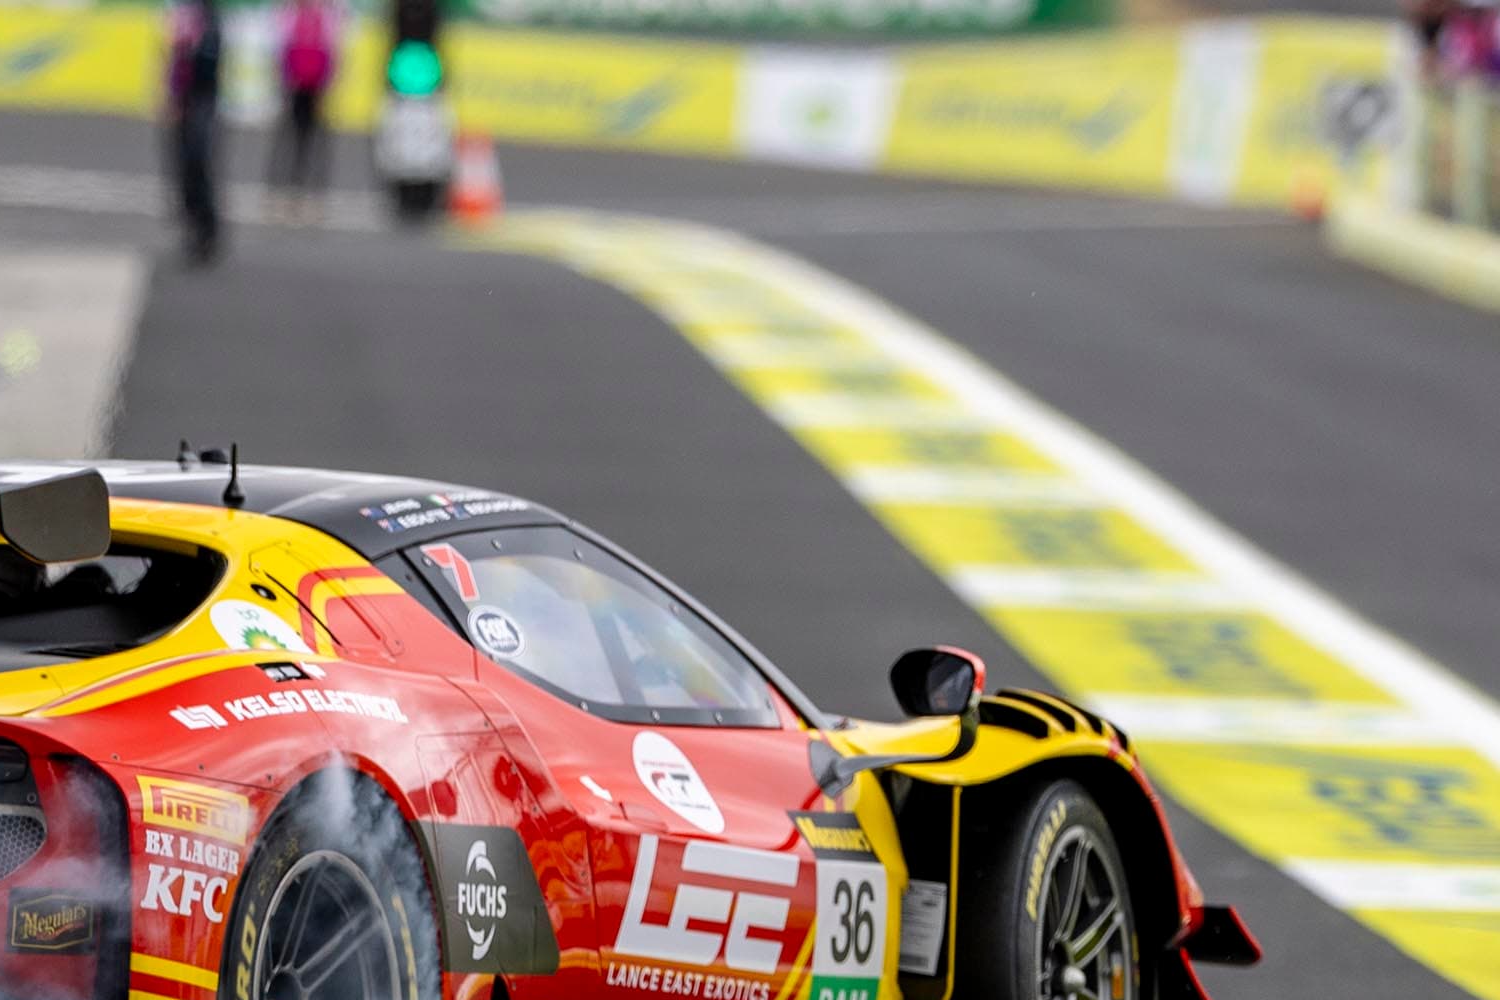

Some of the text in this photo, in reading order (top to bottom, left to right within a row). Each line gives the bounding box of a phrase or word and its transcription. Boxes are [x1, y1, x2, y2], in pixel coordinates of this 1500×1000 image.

[224, 691, 308, 721] KELSO
[145, 829, 175, 859] BX
[179, 836, 240, 876] LAGER
[140, 863, 228, 923] KFC
[458, 883, 508, 919] FUCHS
[831, 879, 875, 964] 36
[606, 962, 663, 992] LANCE
[661, 969, 705, 997] EAST
